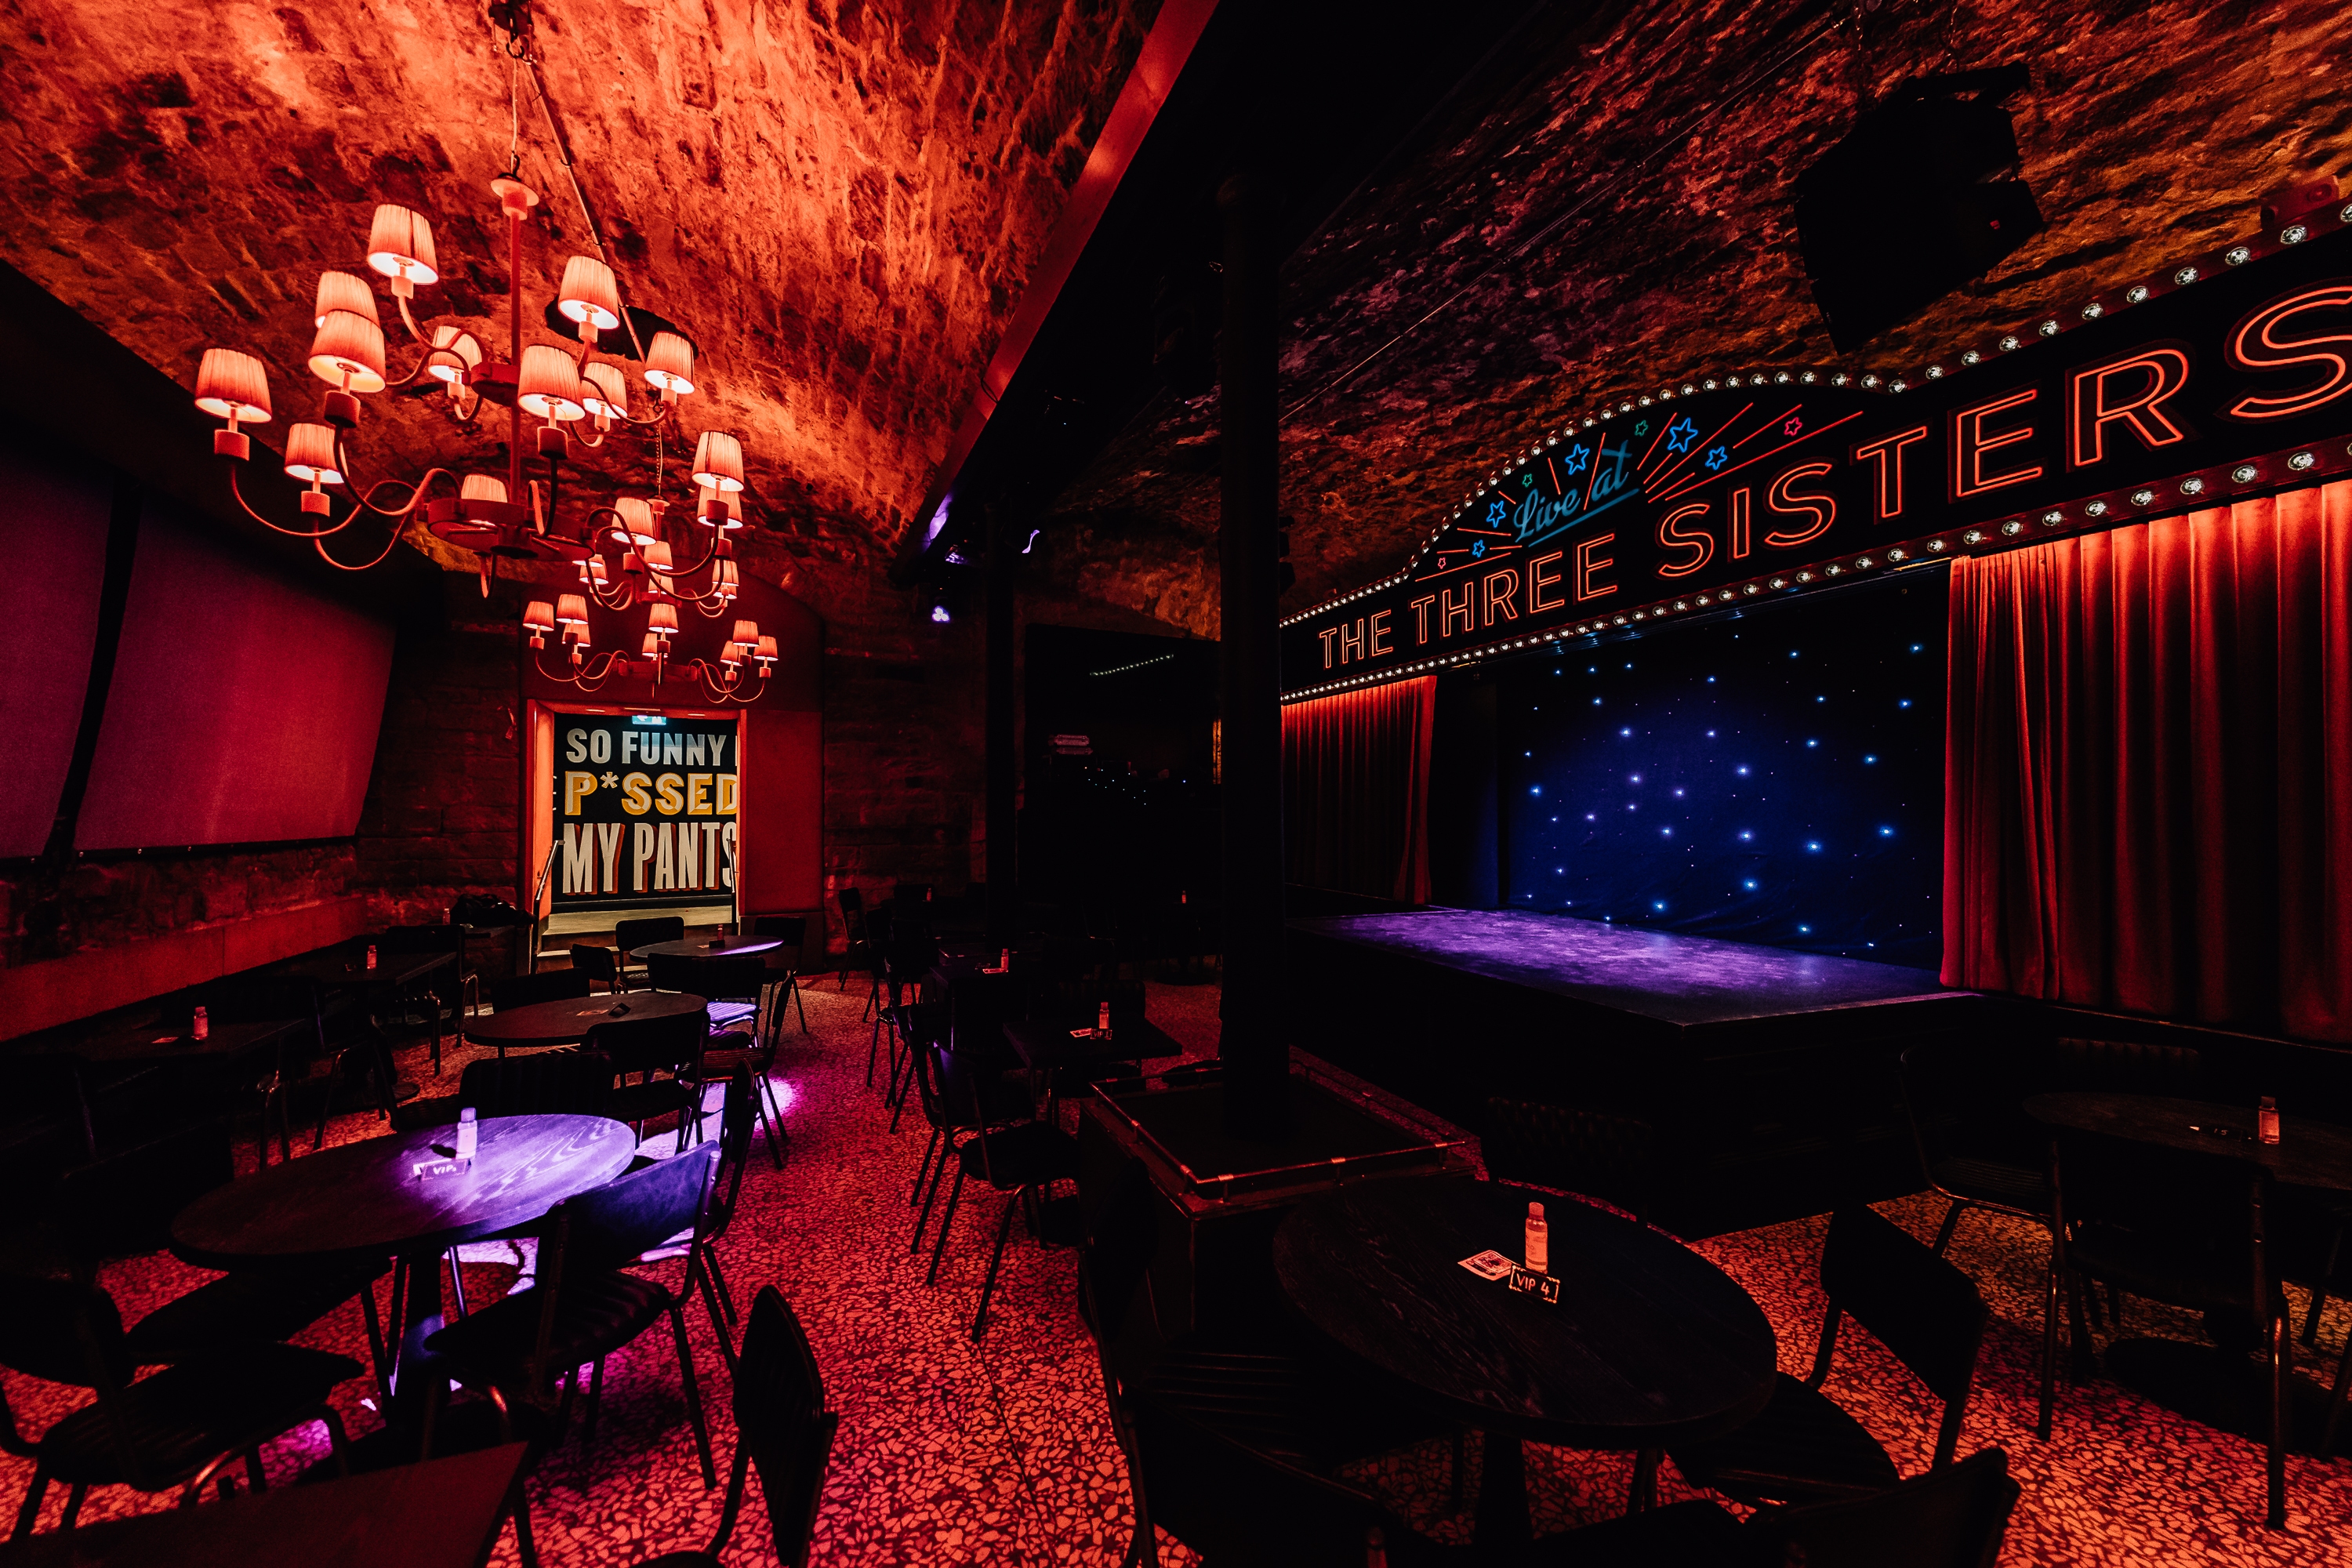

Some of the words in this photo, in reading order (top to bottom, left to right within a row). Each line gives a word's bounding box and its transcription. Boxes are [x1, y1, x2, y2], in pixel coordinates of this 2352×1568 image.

[1319, 609, 1393, 670] THE
[1411, 533, 1618, 644] THREE
[1658, 285, 2352, 578] SISTERS
[1512, 488, 1581, 543] Live
[1591, 439, 1633, 501] at
[566, 728, 612, 764] SO
[622, 730, 728, 767] FUNNY
[562, 823, 624, 895] MY
[633, 821, 737, 893] PANTS
[1516, 1272, 1537, 1291] VIP
[1541, 1281, 1550, 1295] 4
